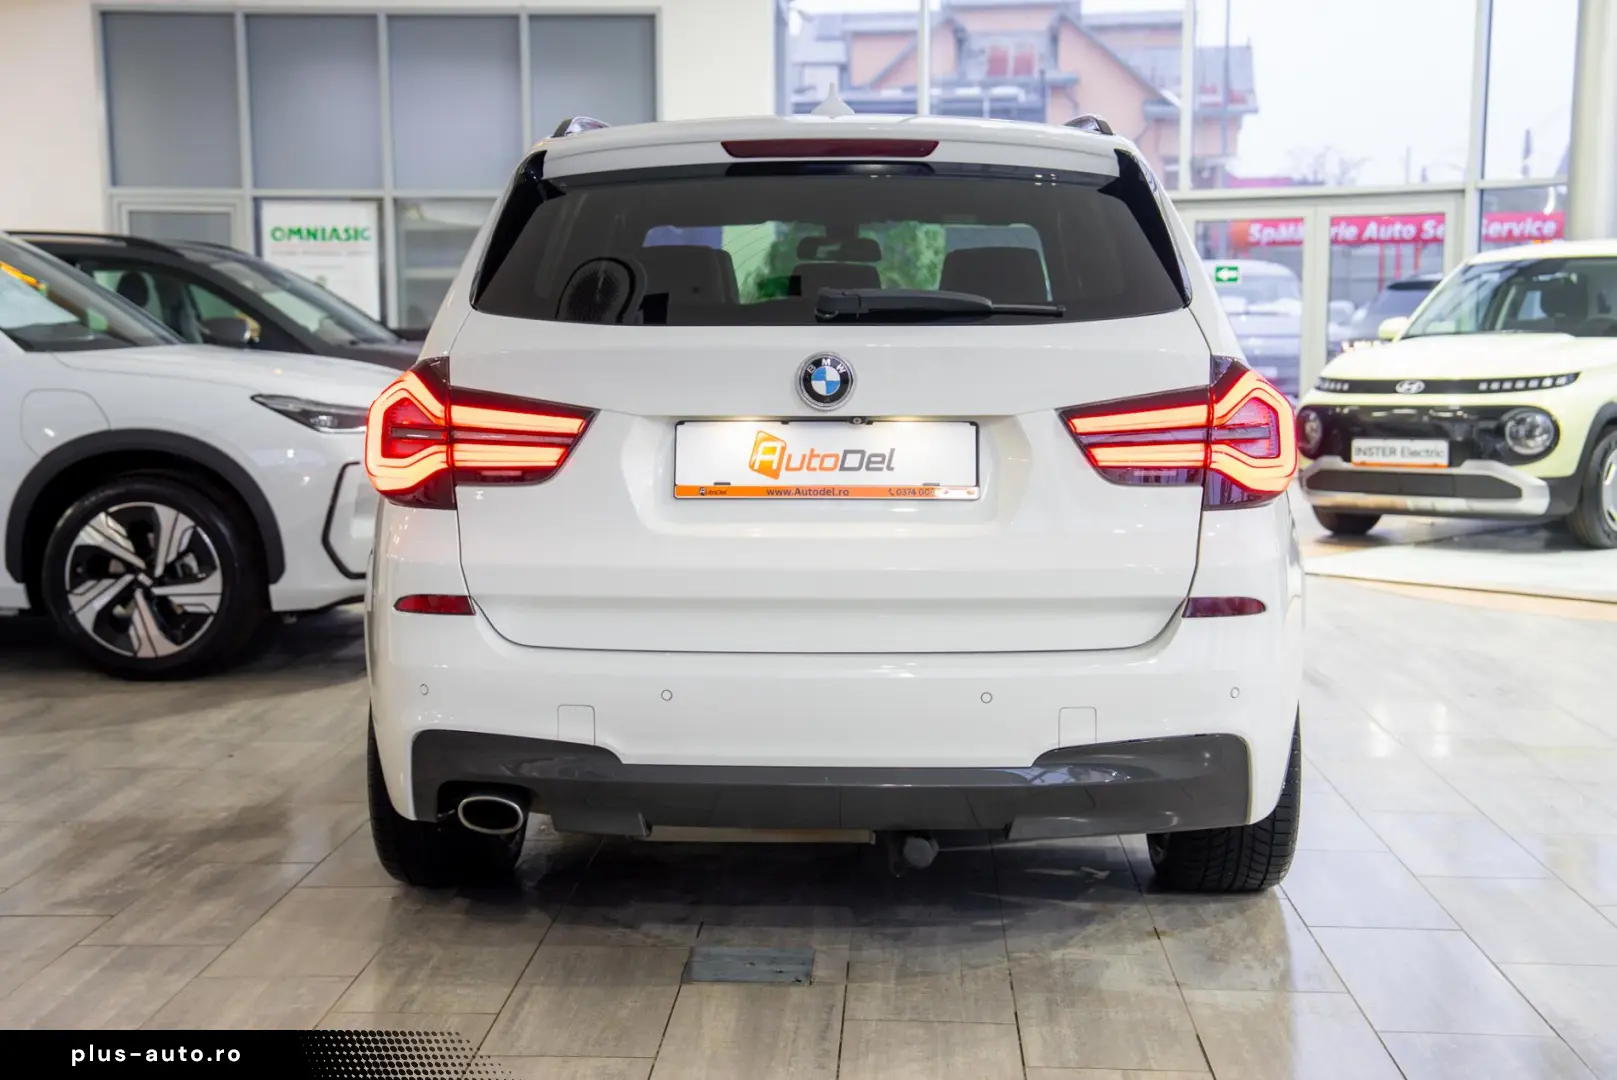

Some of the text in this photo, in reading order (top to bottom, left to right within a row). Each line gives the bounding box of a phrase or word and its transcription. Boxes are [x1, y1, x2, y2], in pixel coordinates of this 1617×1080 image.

[1363, 220, 1416, 241] Auto
[806, 358, 847, 374] BMW
[752, 438, 896, 473] AutoDel
[1354, 446, 1445, 458] INSTER Electric
[766, 487, 849, 497] www.Autodel.ro
